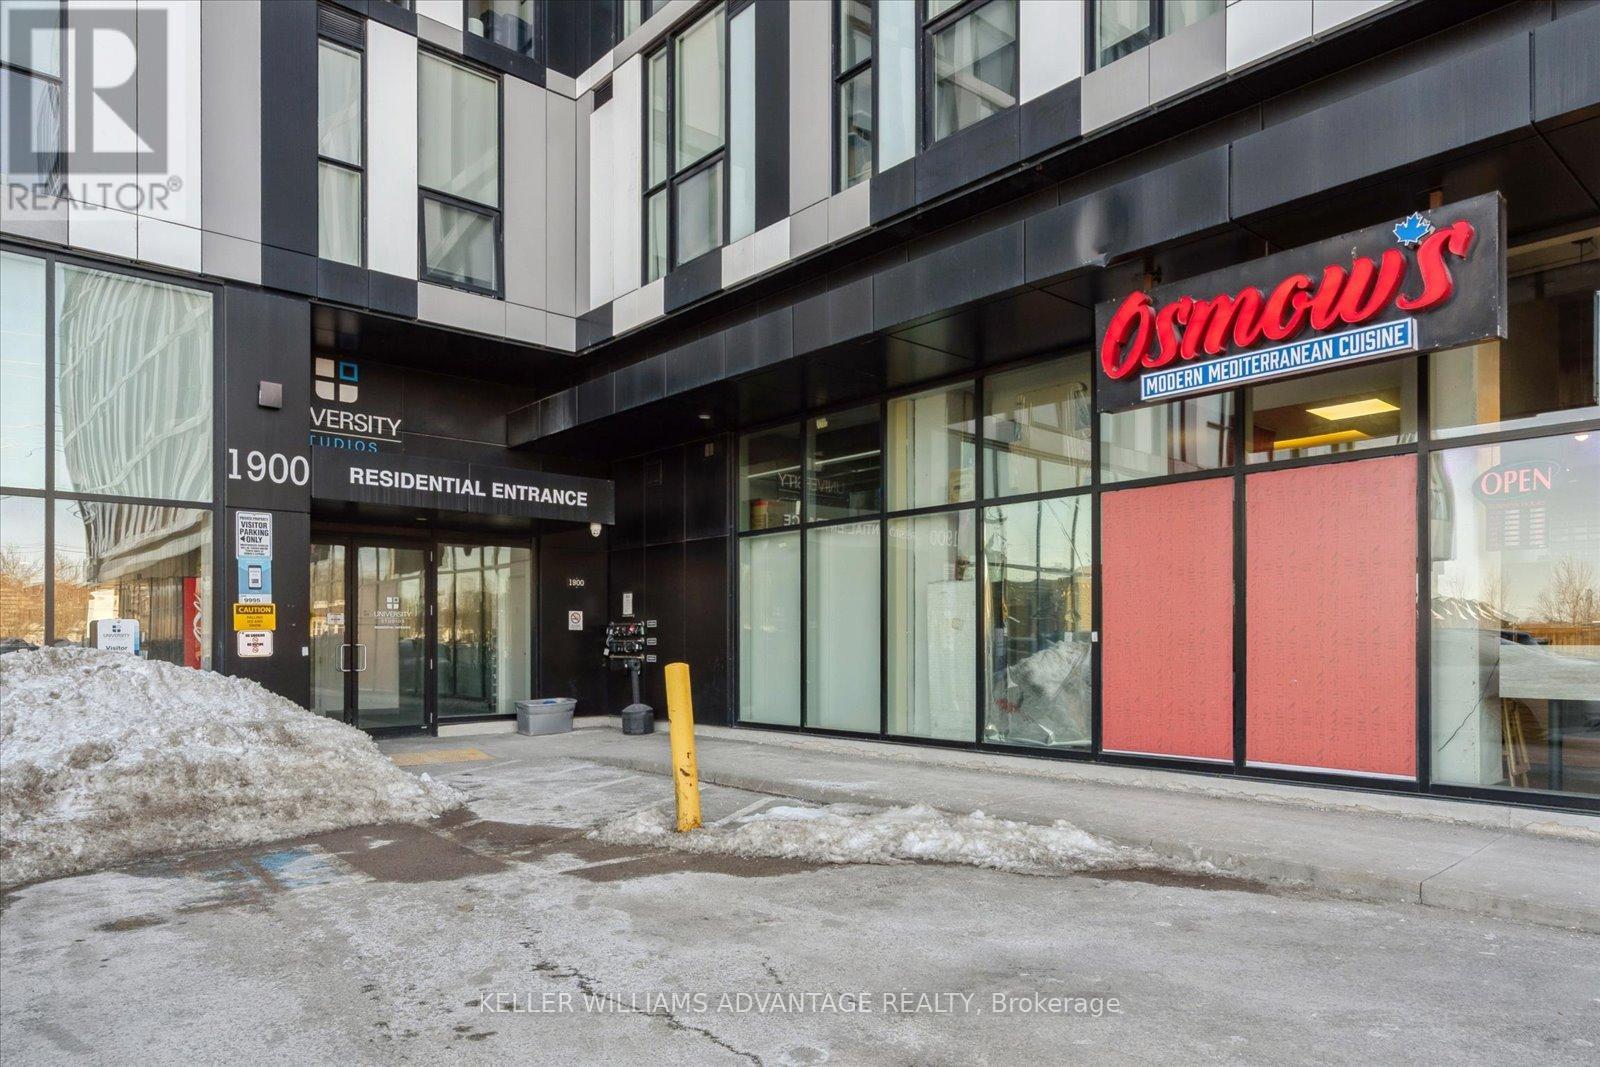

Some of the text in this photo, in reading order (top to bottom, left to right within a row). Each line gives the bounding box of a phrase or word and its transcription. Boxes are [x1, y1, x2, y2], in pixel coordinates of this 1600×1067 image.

[1145, 323, 1405, 395] MODERN MEDITERRANEAN CUISINE
[228, 448, 310, 487] 1900
[1481, 467, 1552, 495] OPEN
[349, 466, 588, 507] RESIDENTIAL ENTRANCE
[240, 528, 269, 537] PARKING
[241, 521, 268, 529] VISITOR
[246, 536, 263, 544] ONLY
